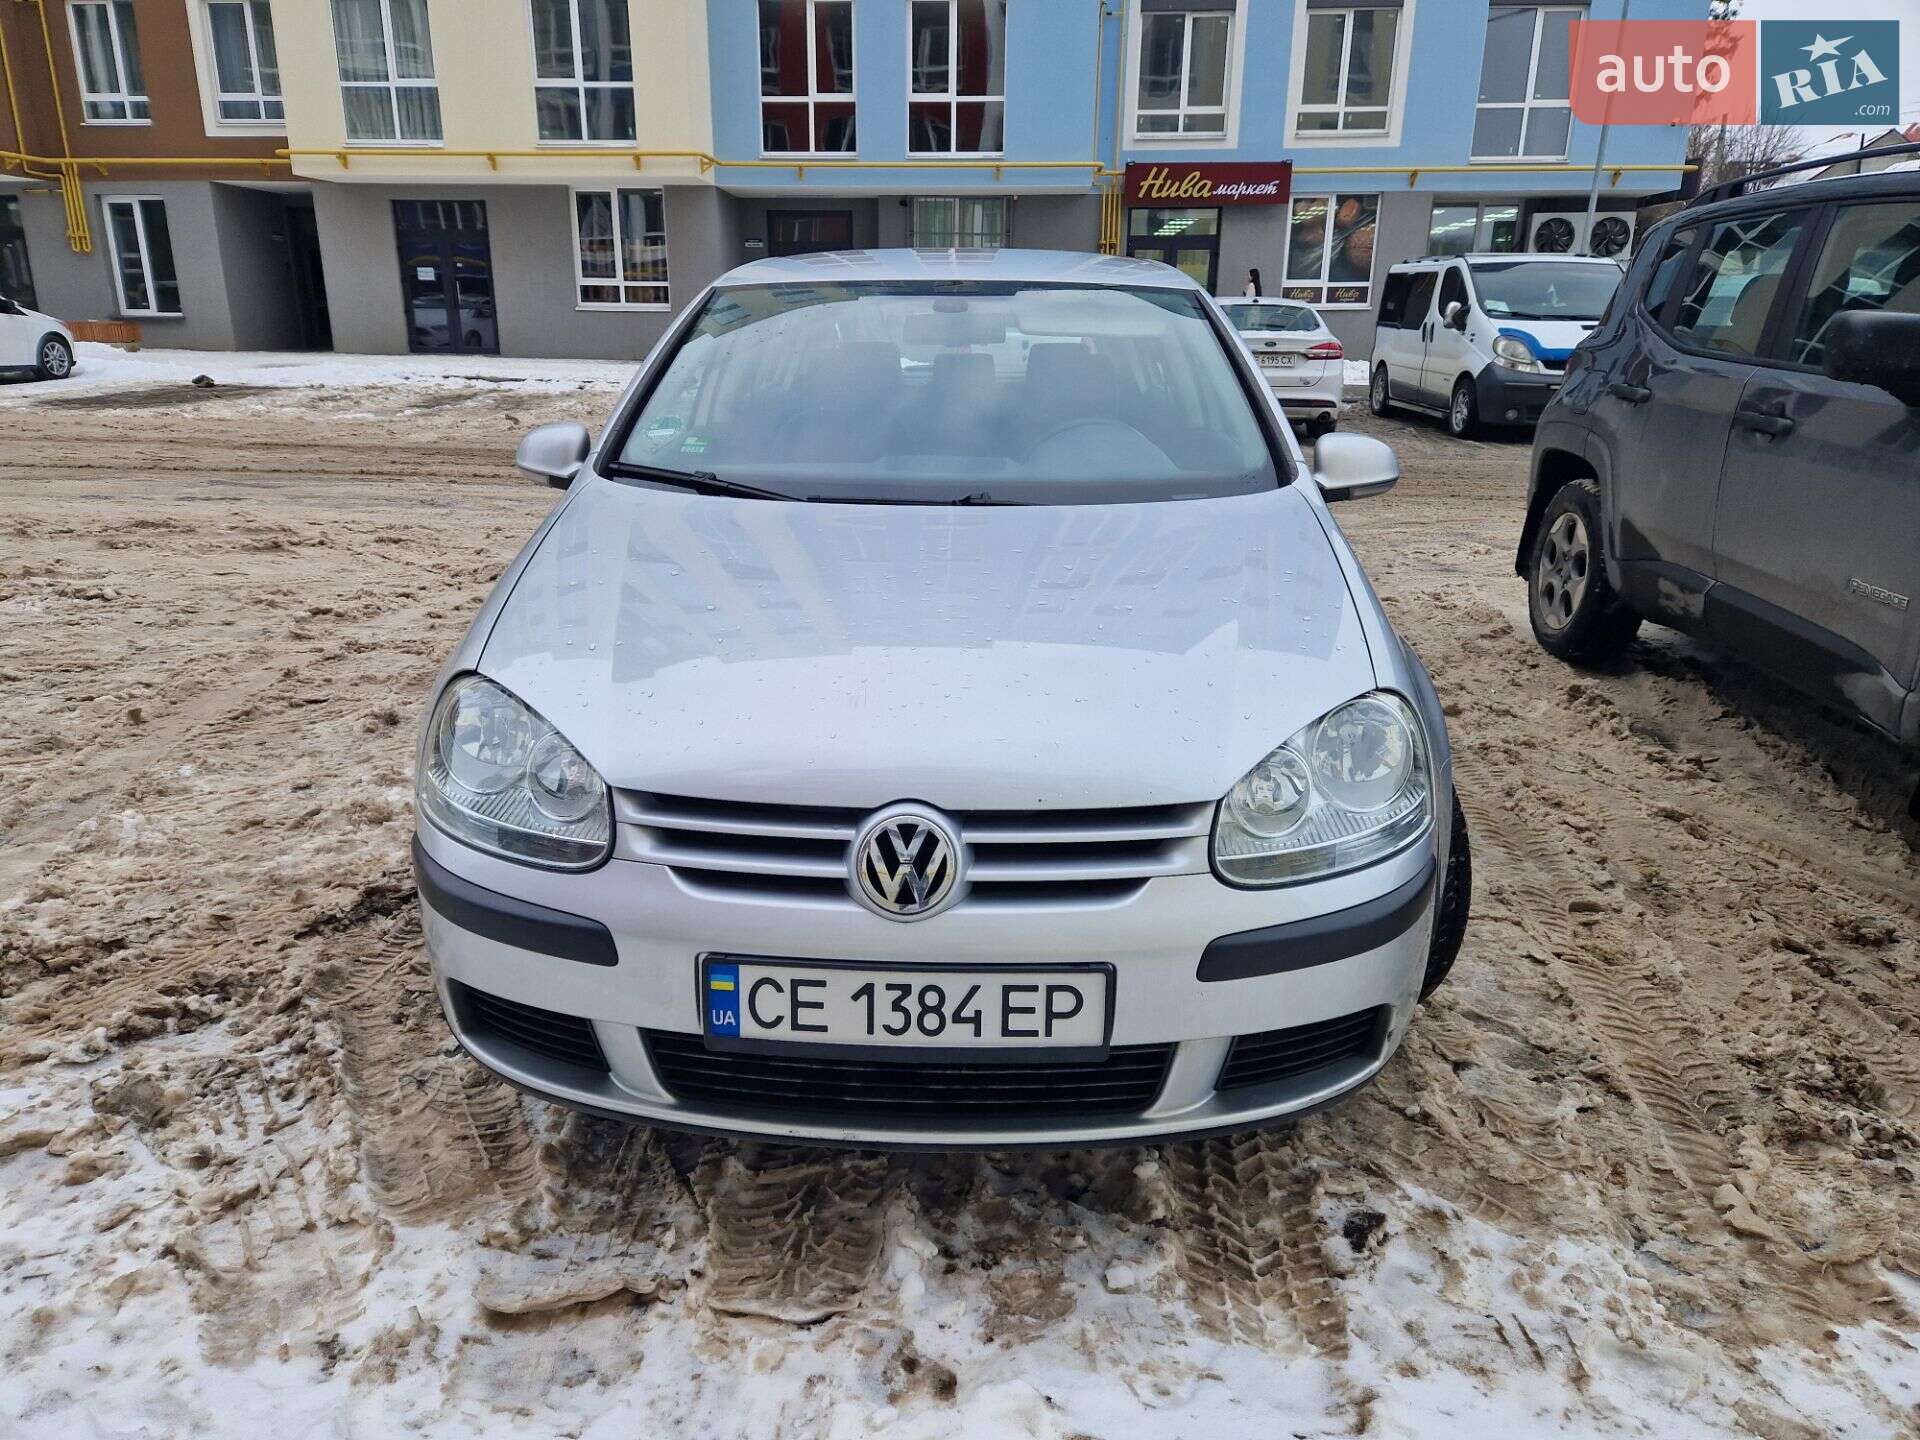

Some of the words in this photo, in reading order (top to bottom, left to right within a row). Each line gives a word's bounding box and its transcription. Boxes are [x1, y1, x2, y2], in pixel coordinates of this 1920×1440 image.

[1137, 166, 1213, 199] Нива
[1212, 179, 1281, 200] маркет
[1335, 287, 1361, 299] Нива
[711, 1009, 737, 1027] UA
[747, 976, 829, 1033] CE
[850, 982, 983, 1037] 1384
[1001, 983, 1085, 1038] EP
